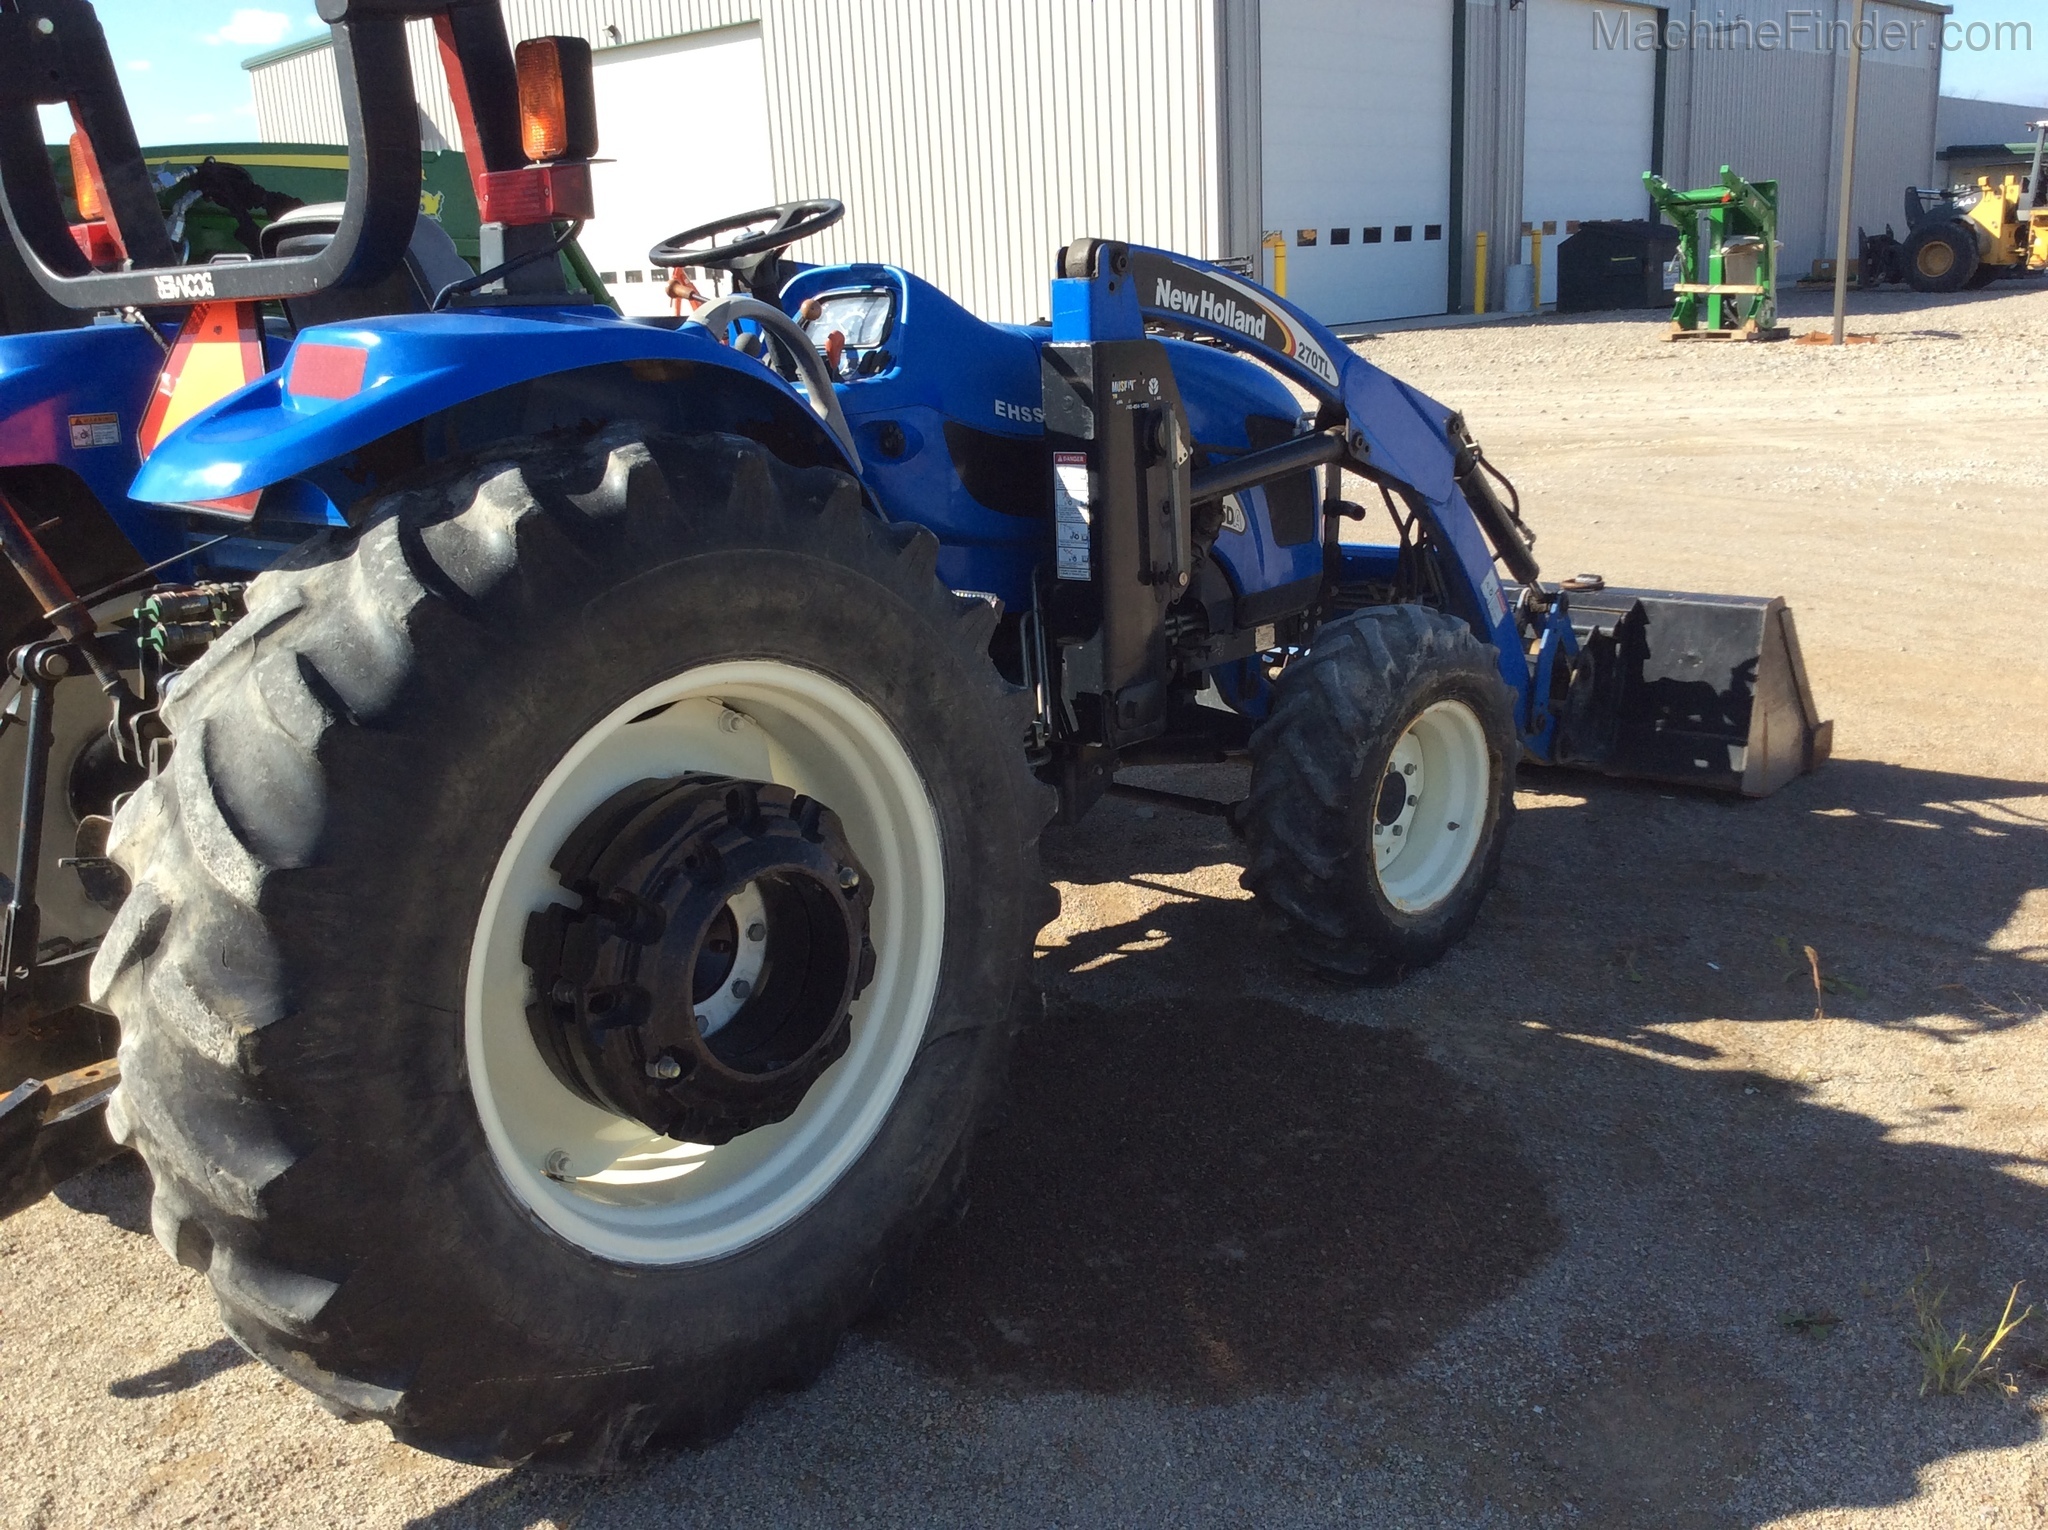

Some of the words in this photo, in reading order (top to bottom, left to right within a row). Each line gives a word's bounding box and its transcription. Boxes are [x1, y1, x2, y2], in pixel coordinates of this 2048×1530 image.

[1155, 277, 1199, 315] New
[1200, 289, 1267, 341] Holland
[1298, 341, 1331, 380] 270TL
[994, 399, 1045, 423] EHSS
